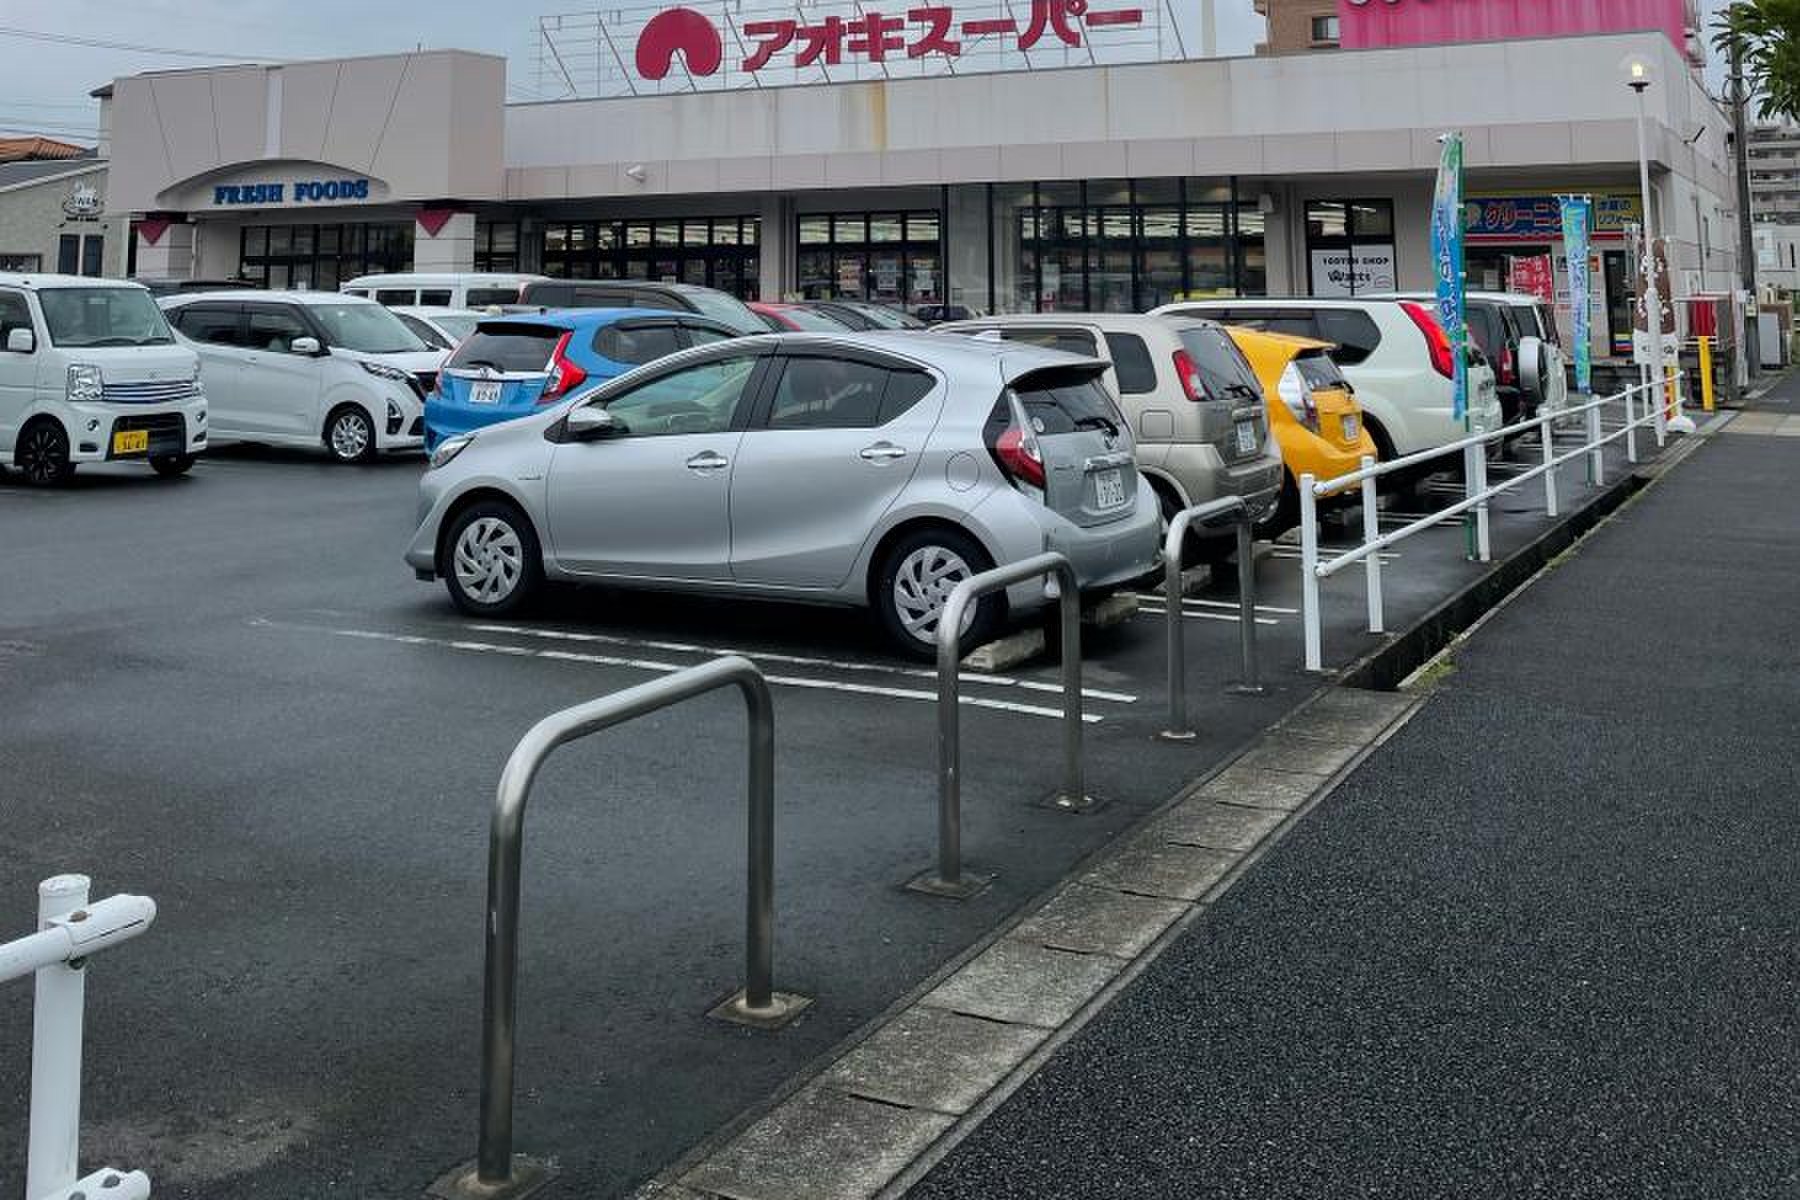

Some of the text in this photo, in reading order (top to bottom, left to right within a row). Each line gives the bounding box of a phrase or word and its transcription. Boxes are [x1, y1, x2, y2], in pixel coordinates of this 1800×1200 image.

[214, 179, 368, 205] FRESH FOODS
[1485, 201, 1564, 230] クリーニン
[1362, 257, 1389, 265] SHOP
